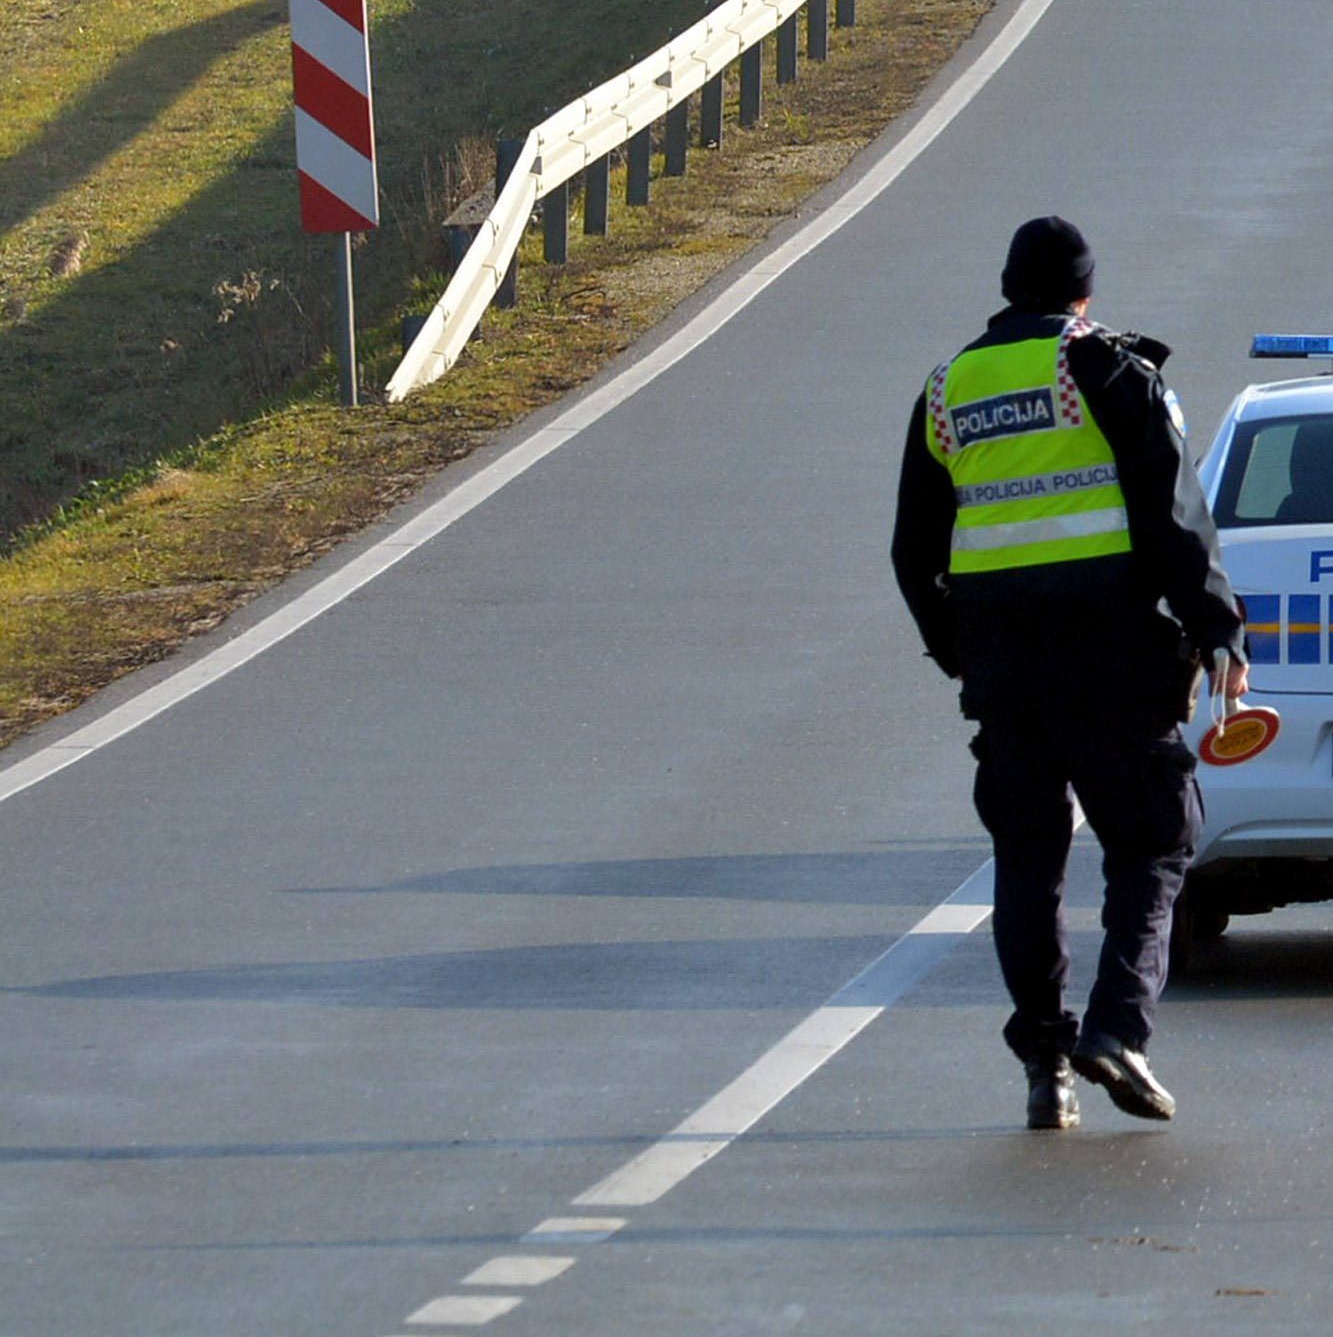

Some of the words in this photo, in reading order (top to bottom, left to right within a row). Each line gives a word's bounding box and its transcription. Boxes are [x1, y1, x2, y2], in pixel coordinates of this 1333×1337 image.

[956, 398, 1049, 439] POLICIJA
[975, 479, 1046, 502] POLICIJA
[1053, 467, 1119, 490] POLICIJ
